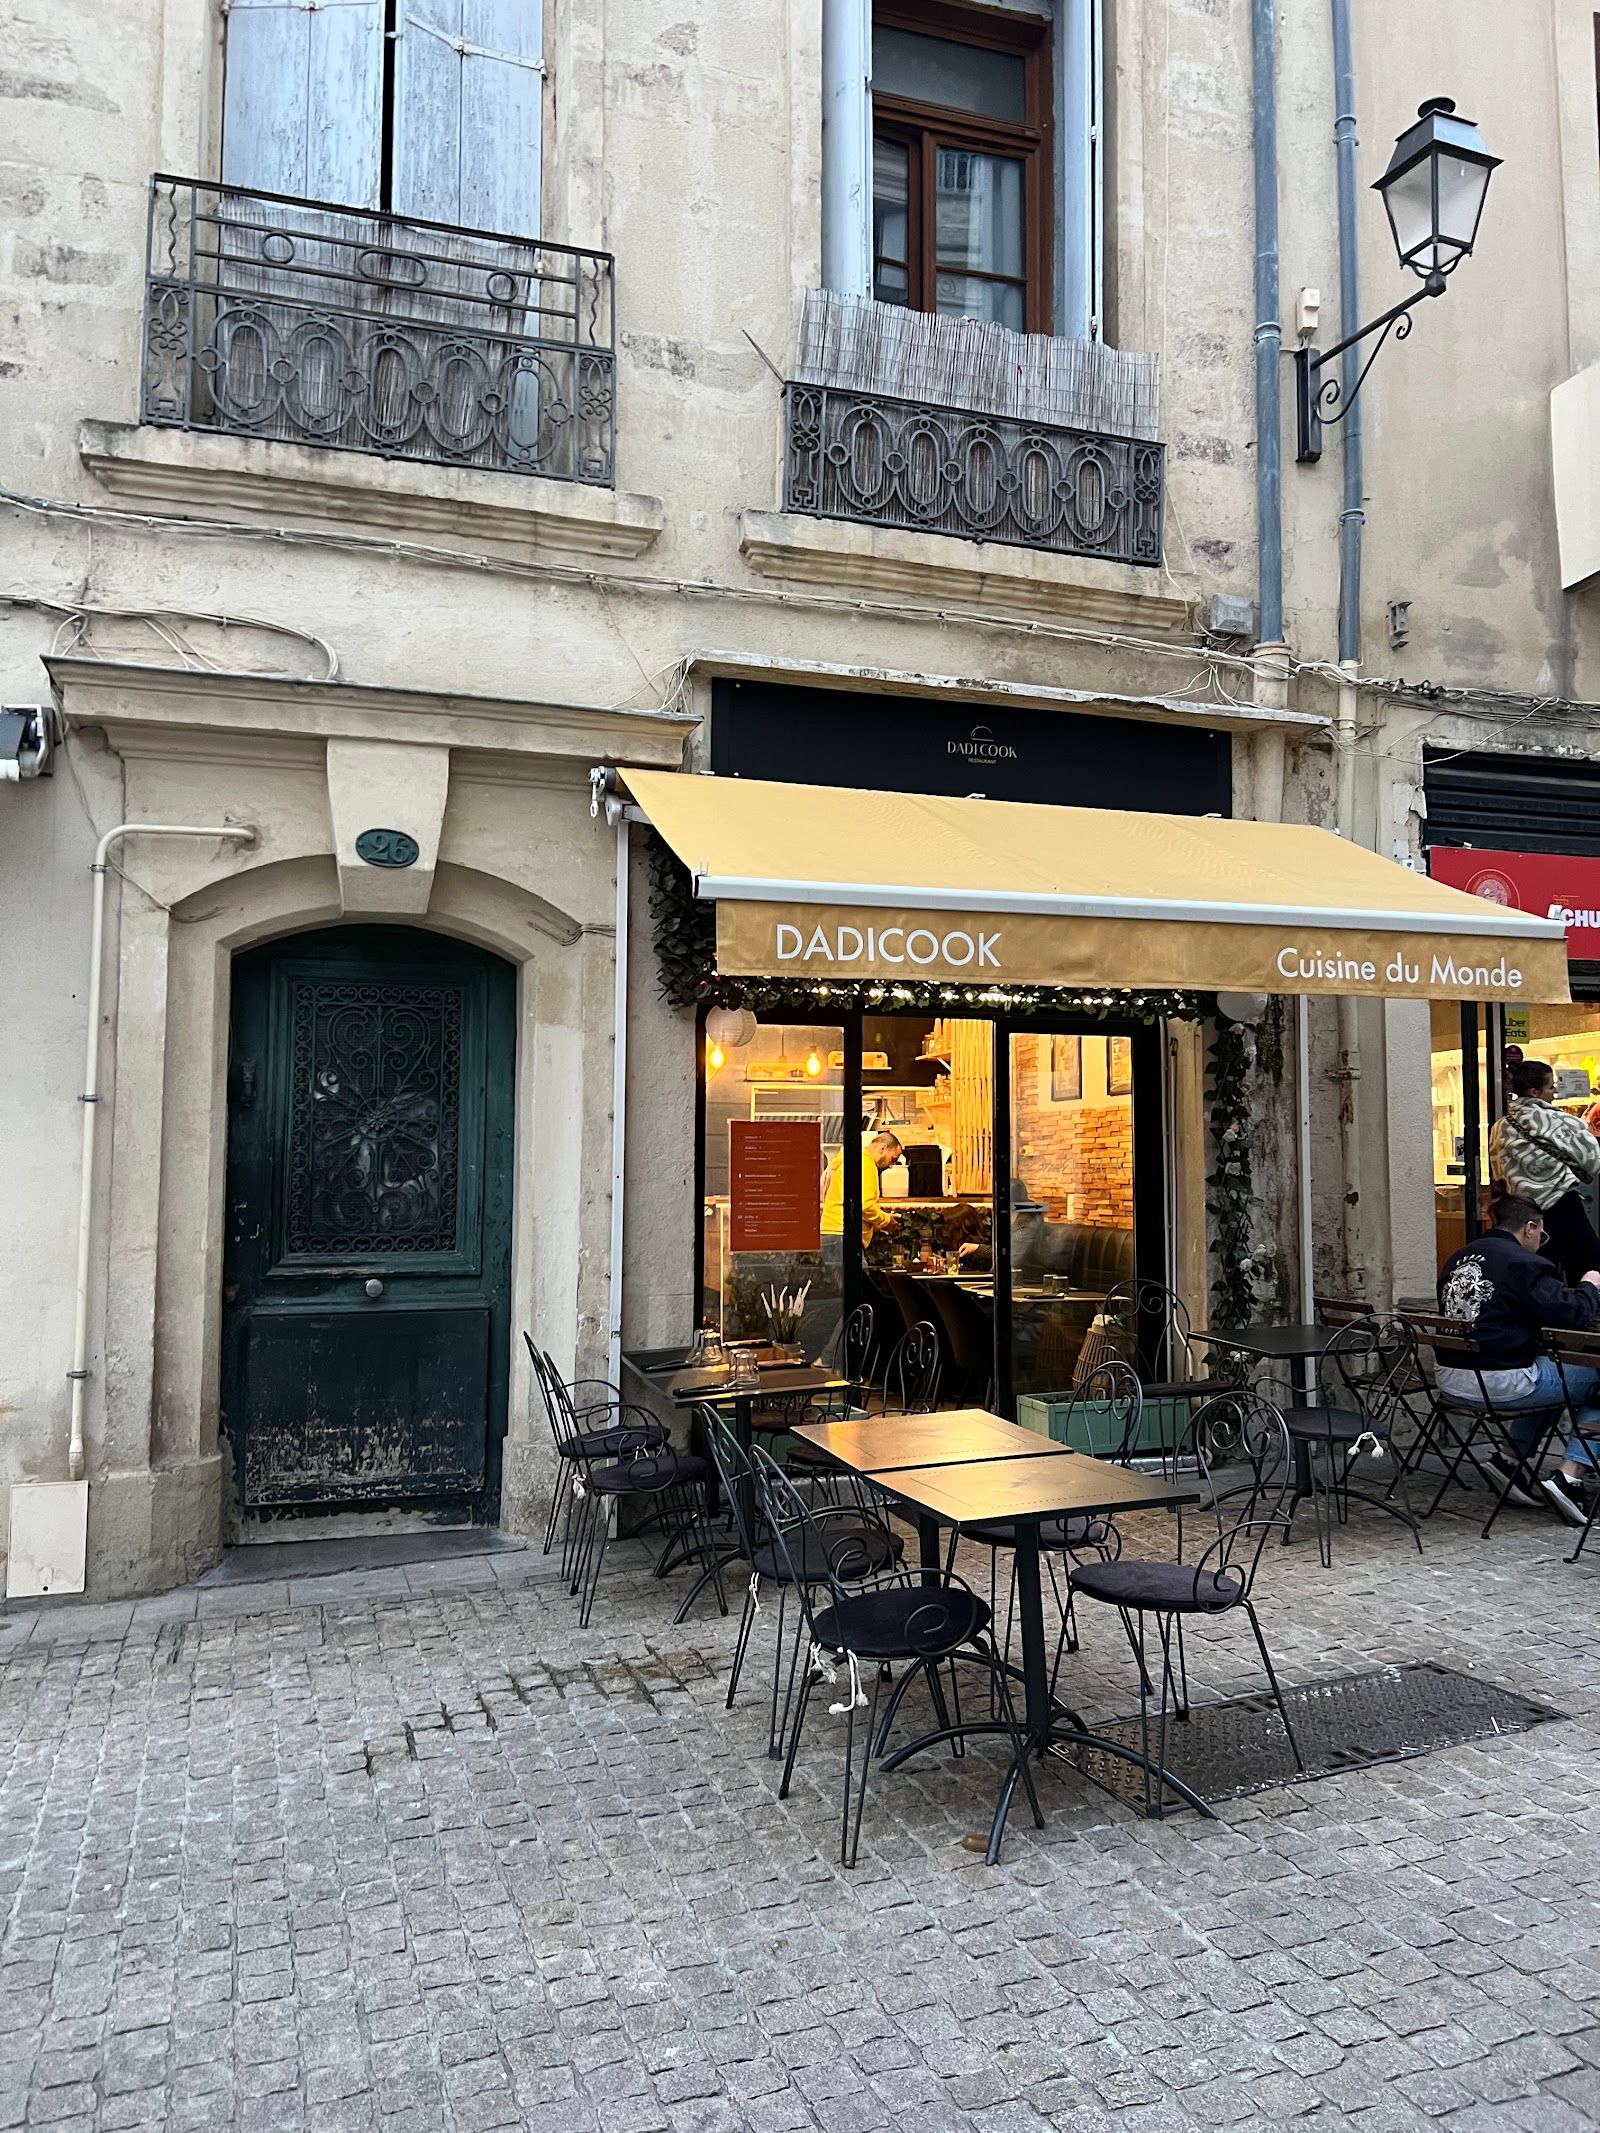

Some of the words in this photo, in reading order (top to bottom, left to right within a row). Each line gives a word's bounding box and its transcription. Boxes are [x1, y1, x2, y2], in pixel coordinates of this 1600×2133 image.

[367, 835, 411, 863] 26
[776, 924, 1002, 967] DADICOOK
[1276, 947, 1376, 981] Cuisine
[1385, 951, 1420, 984] du
[1430, 954, 1523, 988] Monde
[1505, 1028, 1527, 1037] Eats
